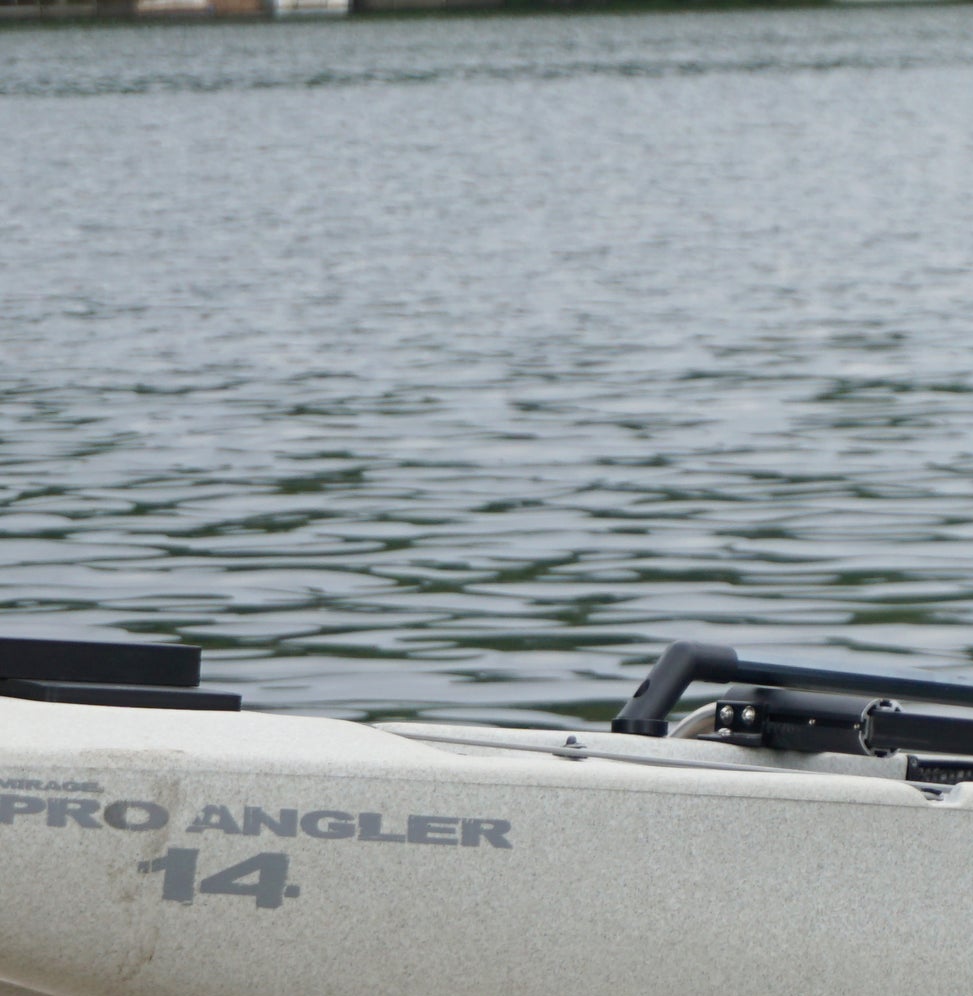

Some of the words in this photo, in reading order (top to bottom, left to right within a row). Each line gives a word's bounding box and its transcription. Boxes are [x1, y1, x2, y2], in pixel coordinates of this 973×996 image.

[0, 794, 170, 832] PRO
[185, 804, 514, 849] ANGLER
[137, 847, 300, 909] 14
